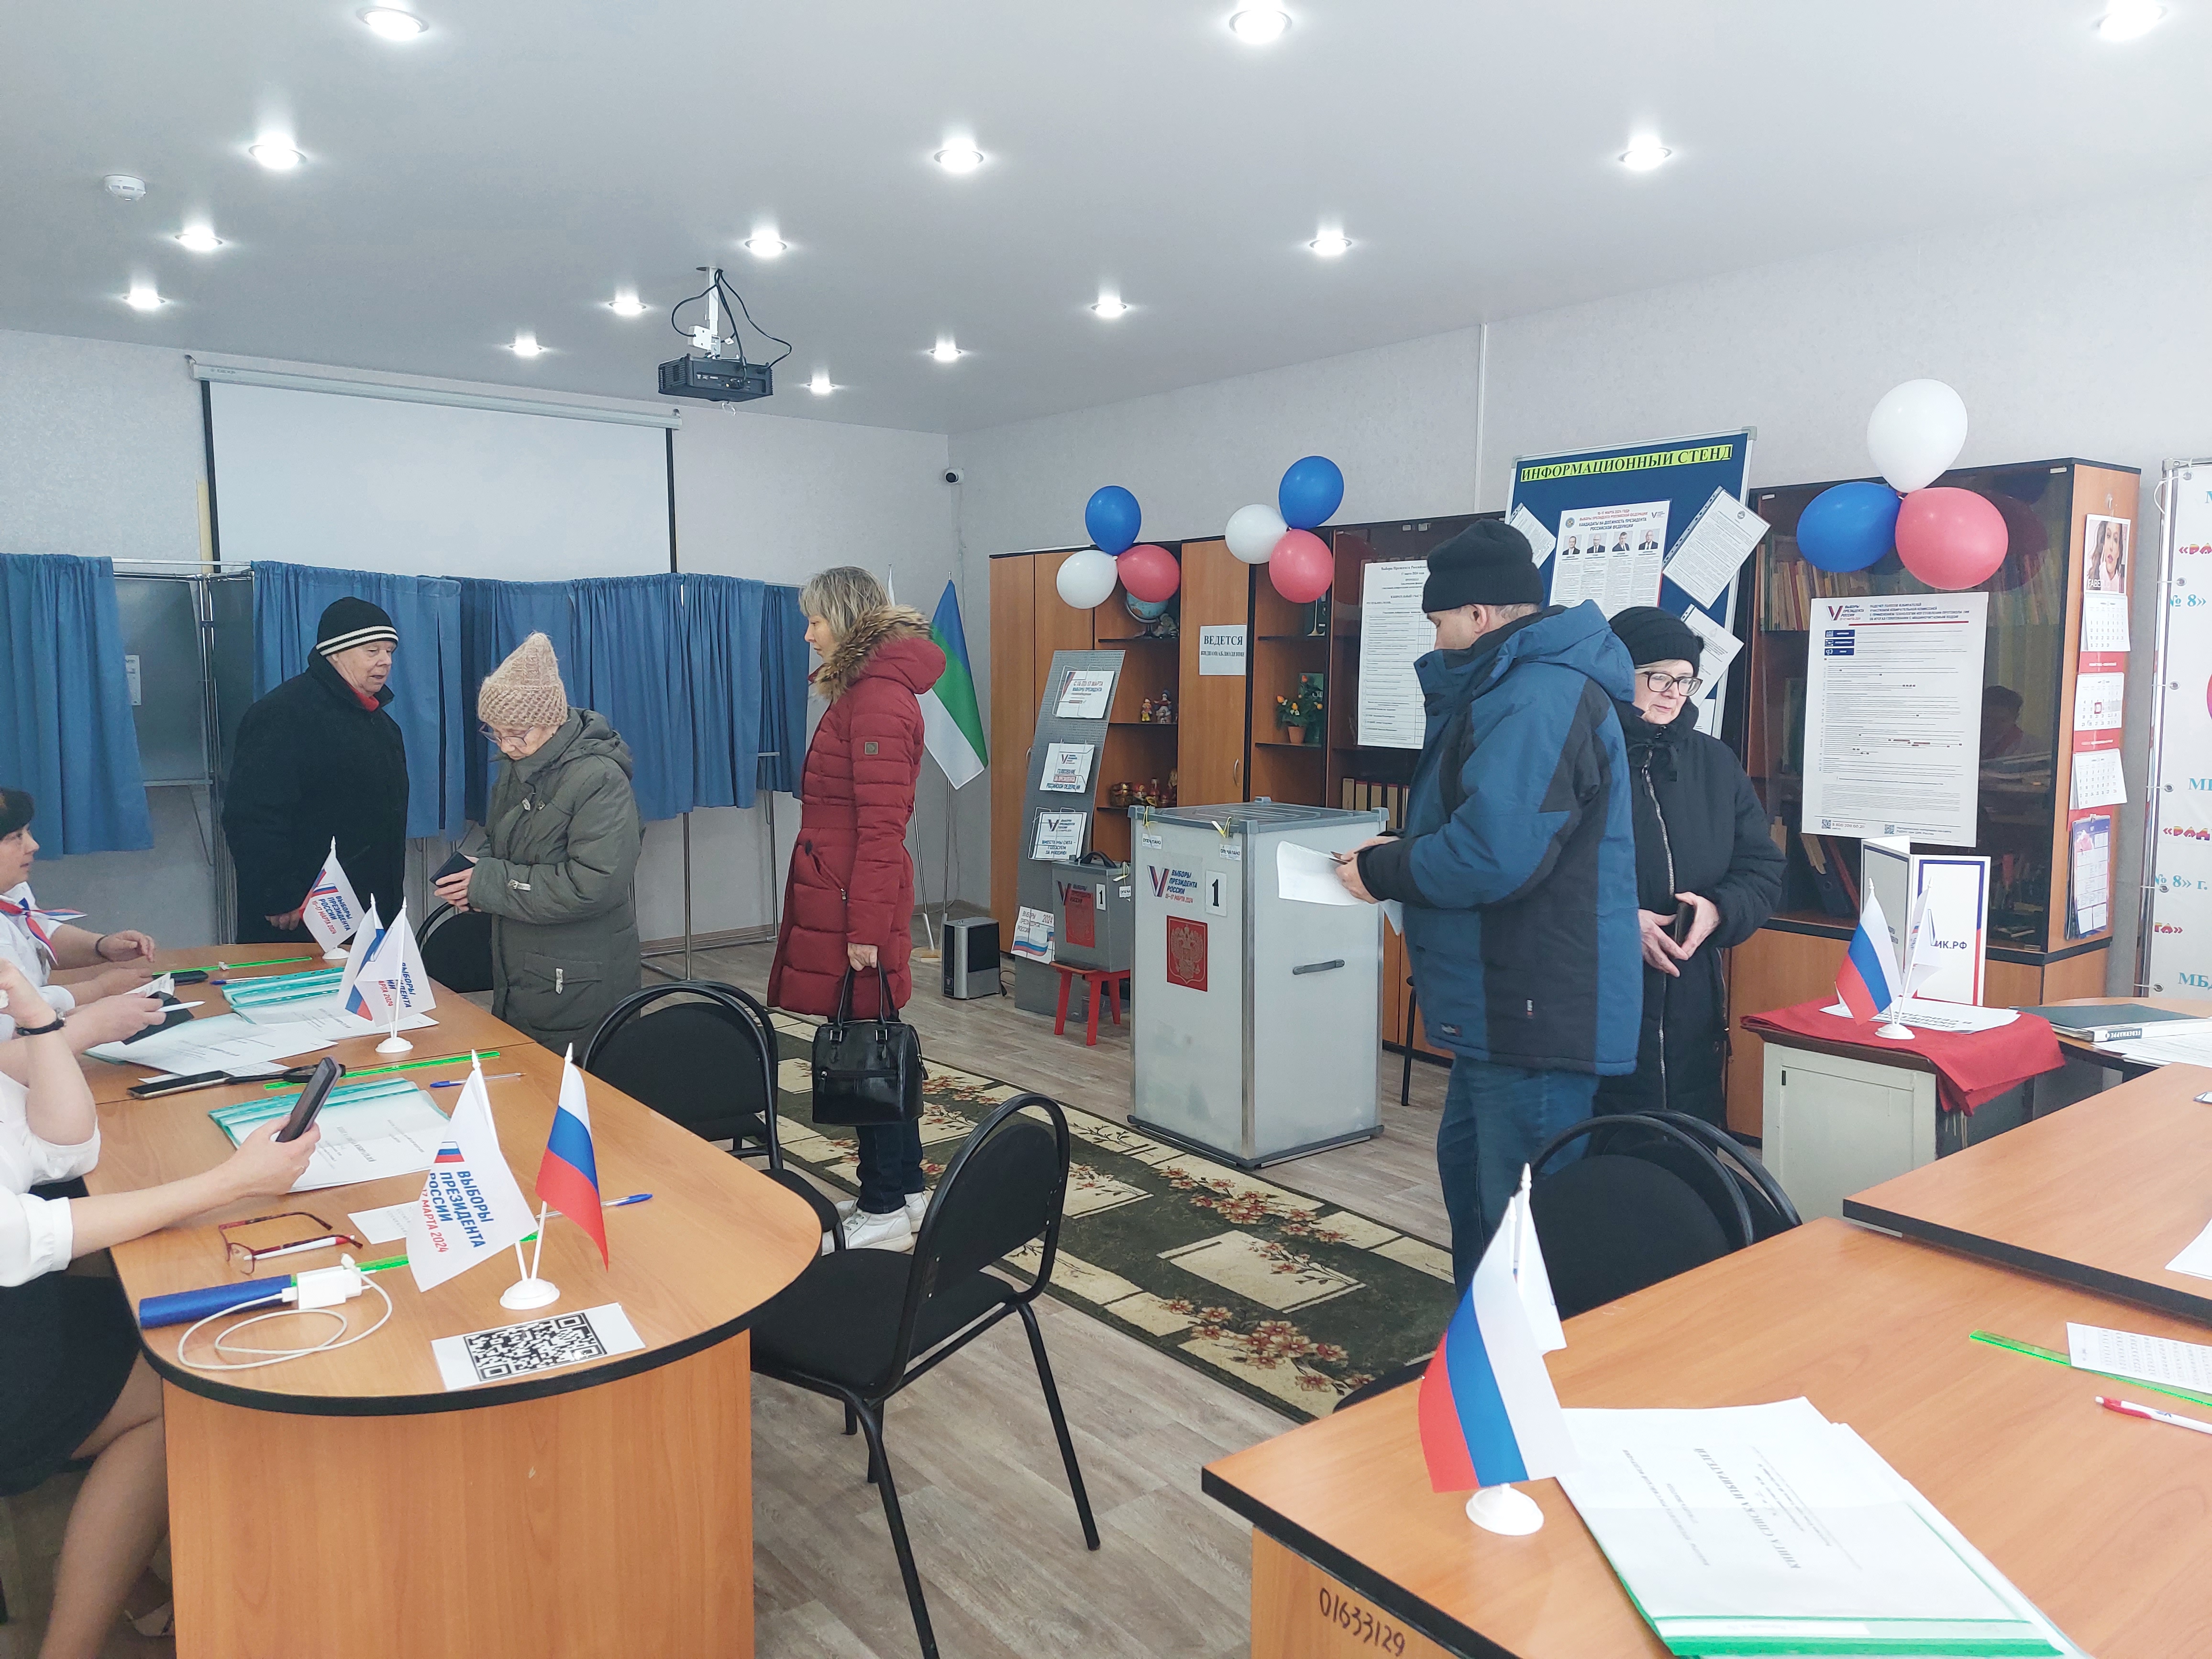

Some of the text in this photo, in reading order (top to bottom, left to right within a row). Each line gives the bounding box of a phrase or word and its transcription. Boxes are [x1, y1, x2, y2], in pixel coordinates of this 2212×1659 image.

[1521, 446, 1732, 481] ИНФОРМАЦИОННЫЙ СТЕНД
[2187, 594, 2206, 607] 8»
[1204, 635, 1243, 645] ВЕДЕТСЯ
[1169, 878, 1197, 888] ПРЕЗИДЕНТА
[1172, 869, 1192, 878] ВЫБОРЫ
[2172, 875, 2192, 888] 8»
[2197, 881, 2208, 890] г.
[1099, 890, 1103, 905] 1
[1167, 885, 1185, 894] РОССИИ
[1212, 879, 1219, 907] 1
[318, 898, 337, 920] РОССИИ
[327, 897, 351, 931] ПРЕЗИДЕНТА
[336, 896, 353, 919] ВЫБОРЫ
[1042, 914, 1053, 924] 2024
[318, 911, 331, 924] МАРТА
[327, 925, 337, 934] 2024
[1936, 940, 1967, 950] ИК.РФ
[378, 981, 388, 993] АРТА
[384, 994, 393, 1006] 2024
[429, 1172, 453, 1221] РОССИИ
[456, 1171, 494, 1222] ВЫБОРЫ
[440, 1172, 486, 1248] ПРЕЗИДЕНТА
[421, 1199, 449, 1252] МАРТА 2024
[1319, 1587, 1405, 1657] 01633129
